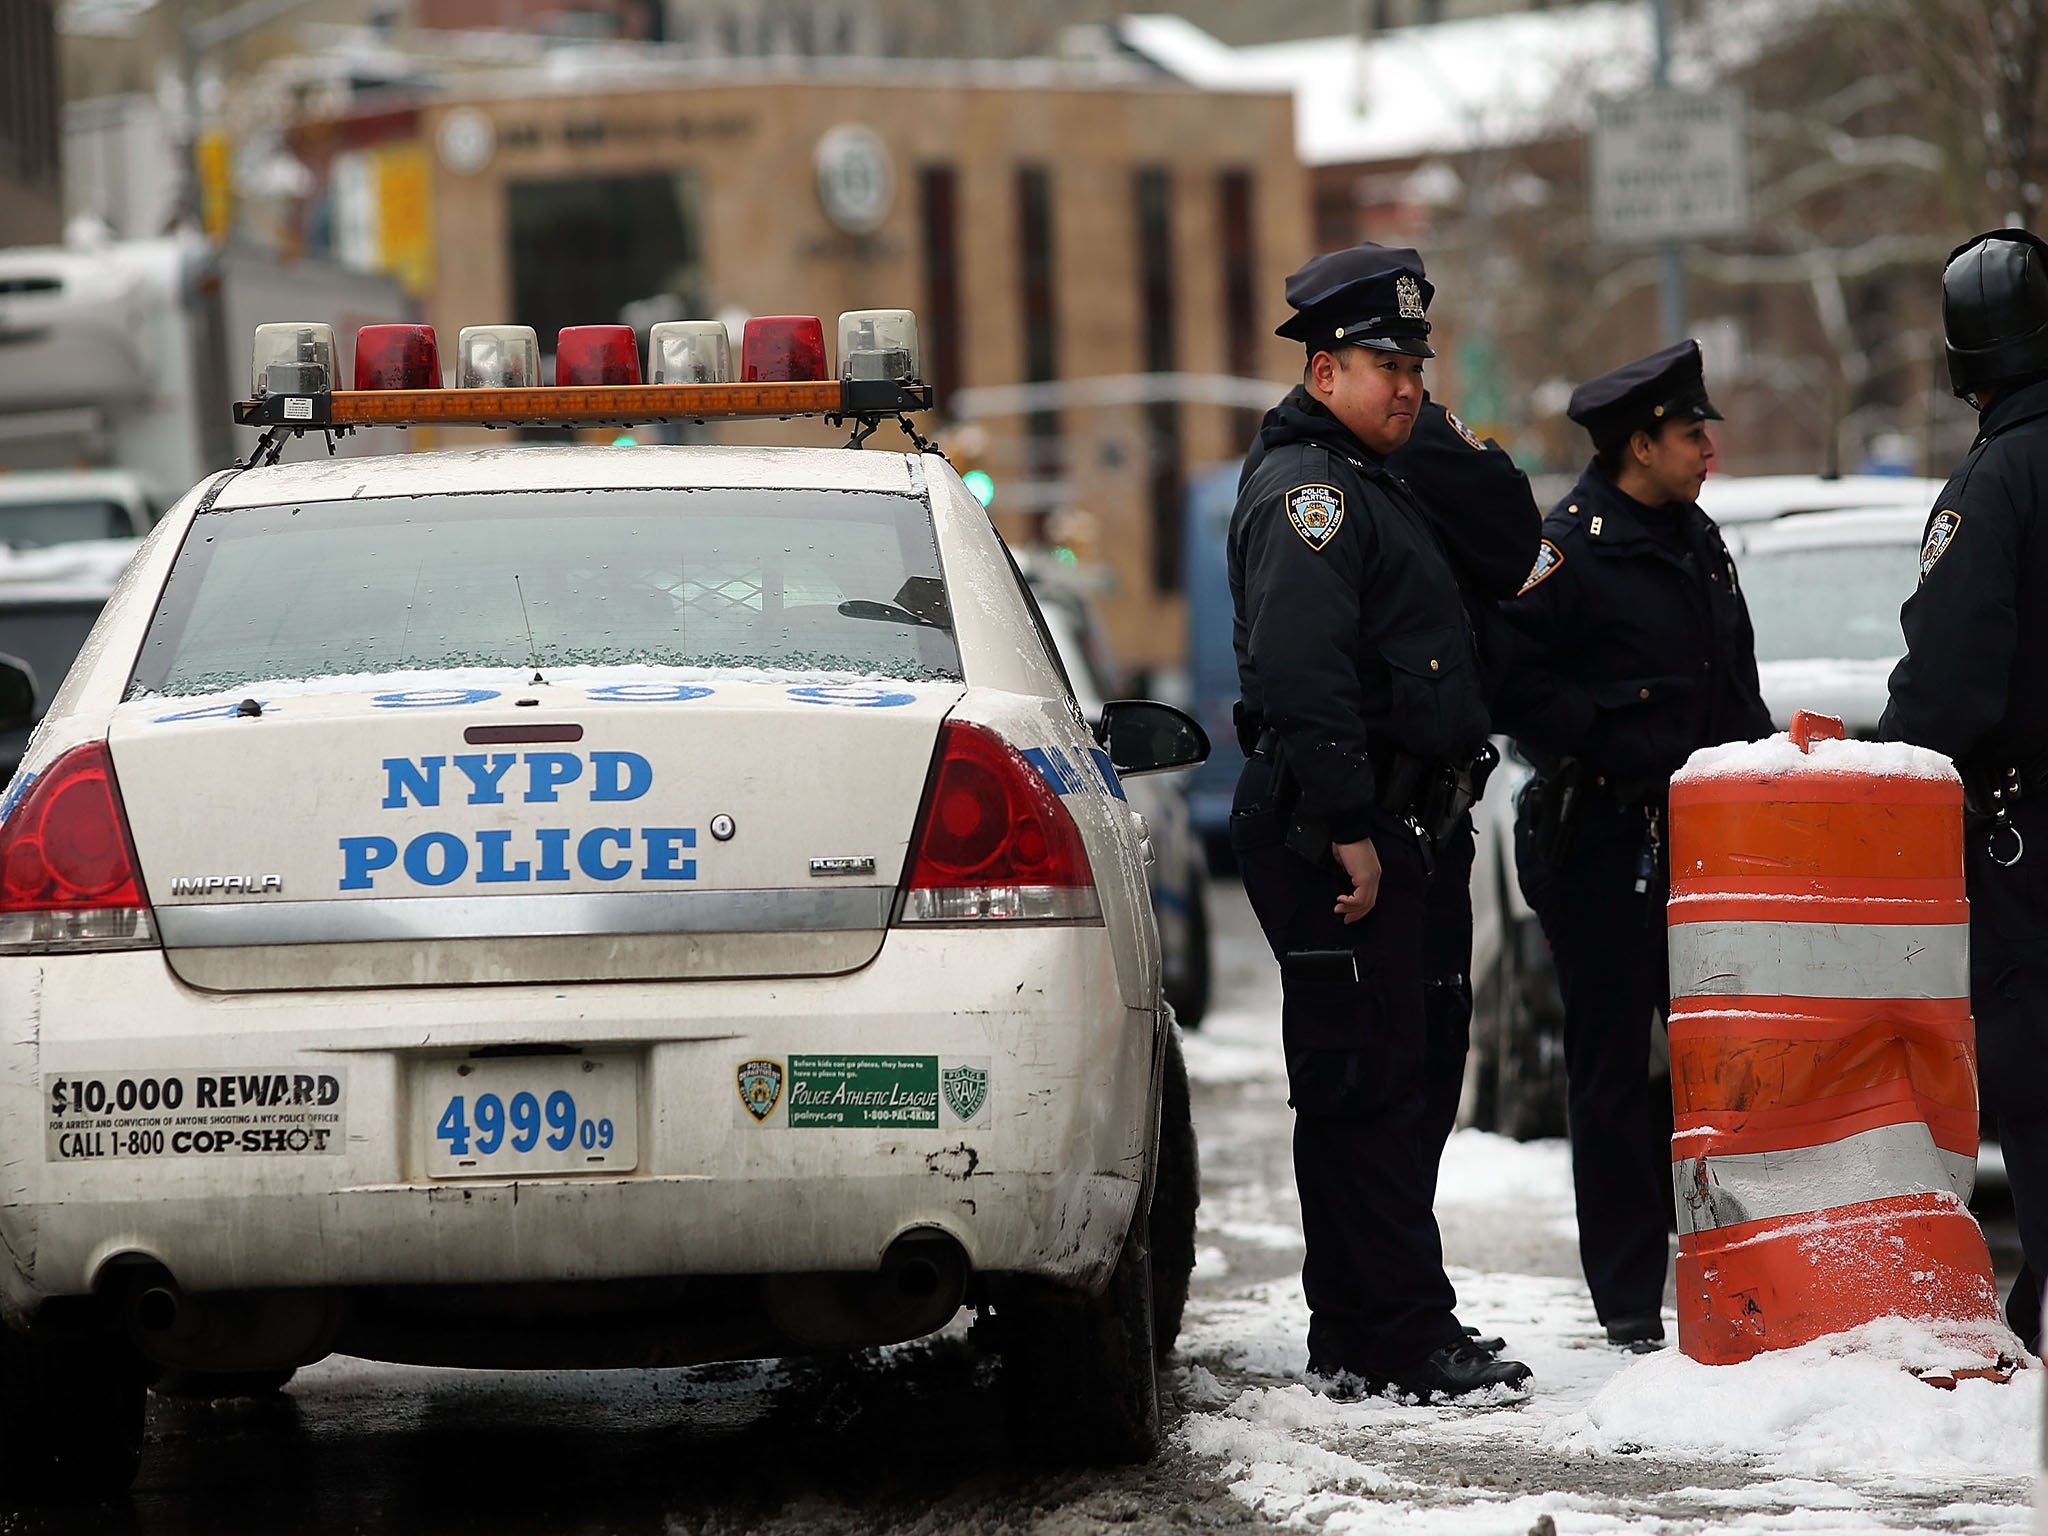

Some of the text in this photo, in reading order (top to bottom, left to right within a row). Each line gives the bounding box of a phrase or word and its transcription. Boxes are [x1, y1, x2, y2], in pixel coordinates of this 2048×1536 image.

[1291, 495, 1339, 507] DEPARTMENT
[1301, 488, 1329, 496] POLICE
[1291, 512, 1311, 538] CITY OF
[1320, 509, 1341, 541] NEW YORK
[382, 751, 653, 809] NYPD
[339, 827, 697, 890] POLICE
[171, 874, 282, 896] IMPALA
[52, 1075, 340, 1117] $10,000 REWARD
[954, 1080, 976, 1102] PAL
[50, 1113, 339, 1130] FOR ARREST AND CONVICTION OF ANYONE SHOOTING A NYC POLICE OFFICER
[436, 1089, 614, 1156] 4999 09
[794, 1110, 936, 1122] palnyc.org 1-800-PAL-4KIDS
[59, 1125, 331, 1158] CALL 1-800 COP-SHOT
